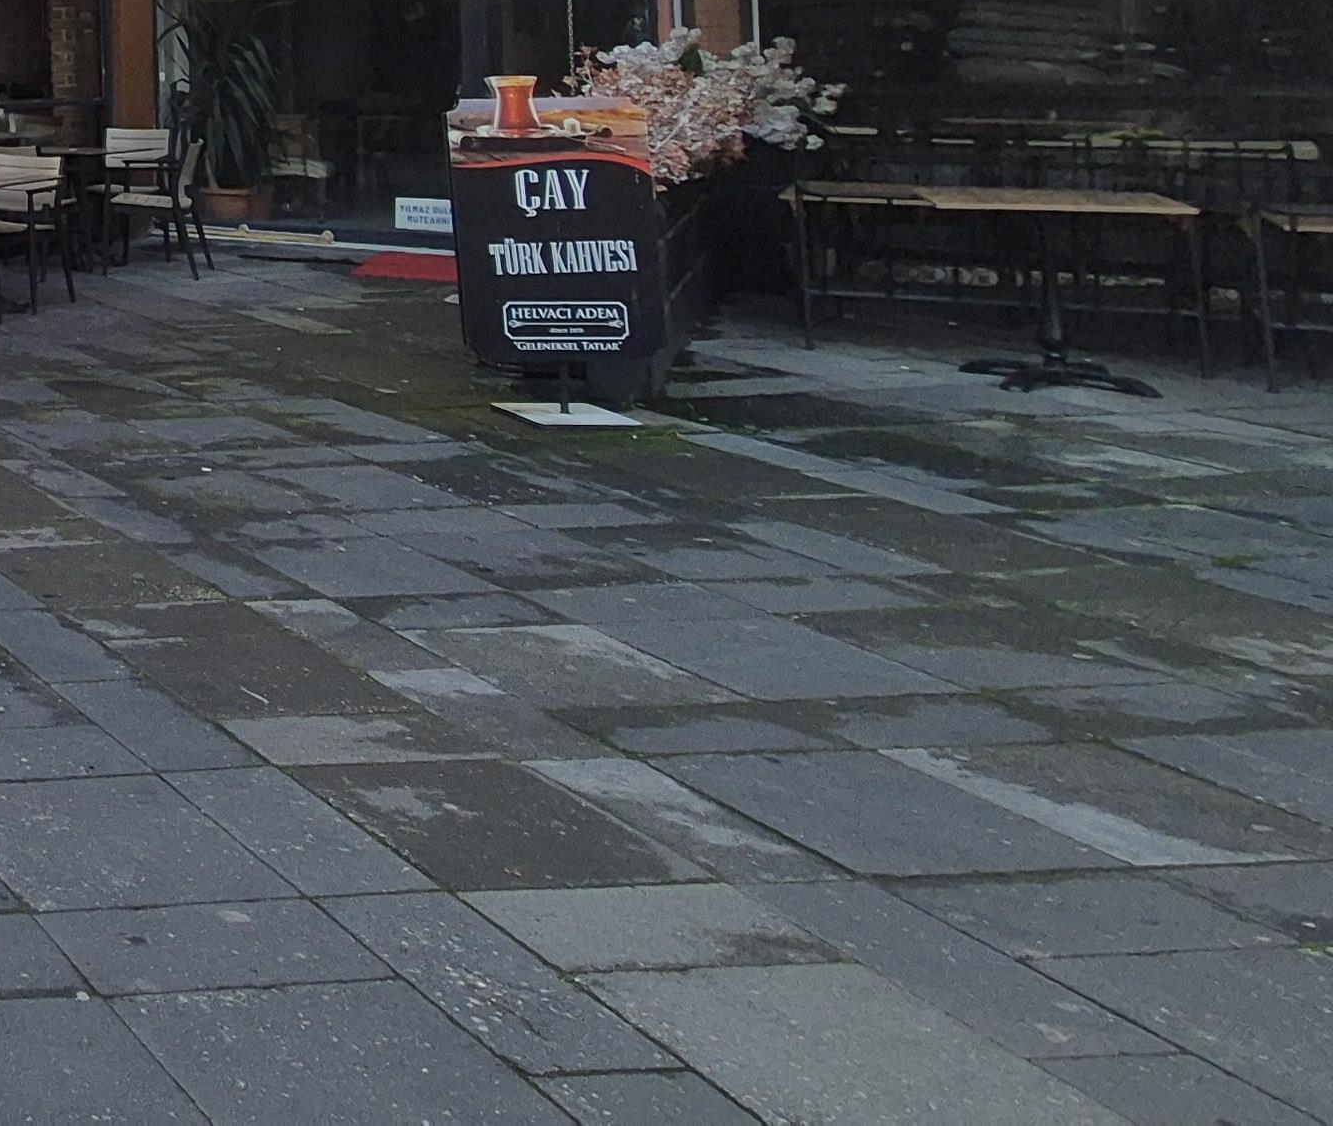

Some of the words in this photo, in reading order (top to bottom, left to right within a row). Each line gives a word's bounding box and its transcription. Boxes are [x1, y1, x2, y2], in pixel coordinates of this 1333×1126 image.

[515, 168, 590, 218] ÇAY
[488, 238, 549, 277] TÜRK
[551, 240, 638, 275] KAHVESİ
[511, 307, 573, 320] HELVACI
[576, 307, 620, 320] ADEM
